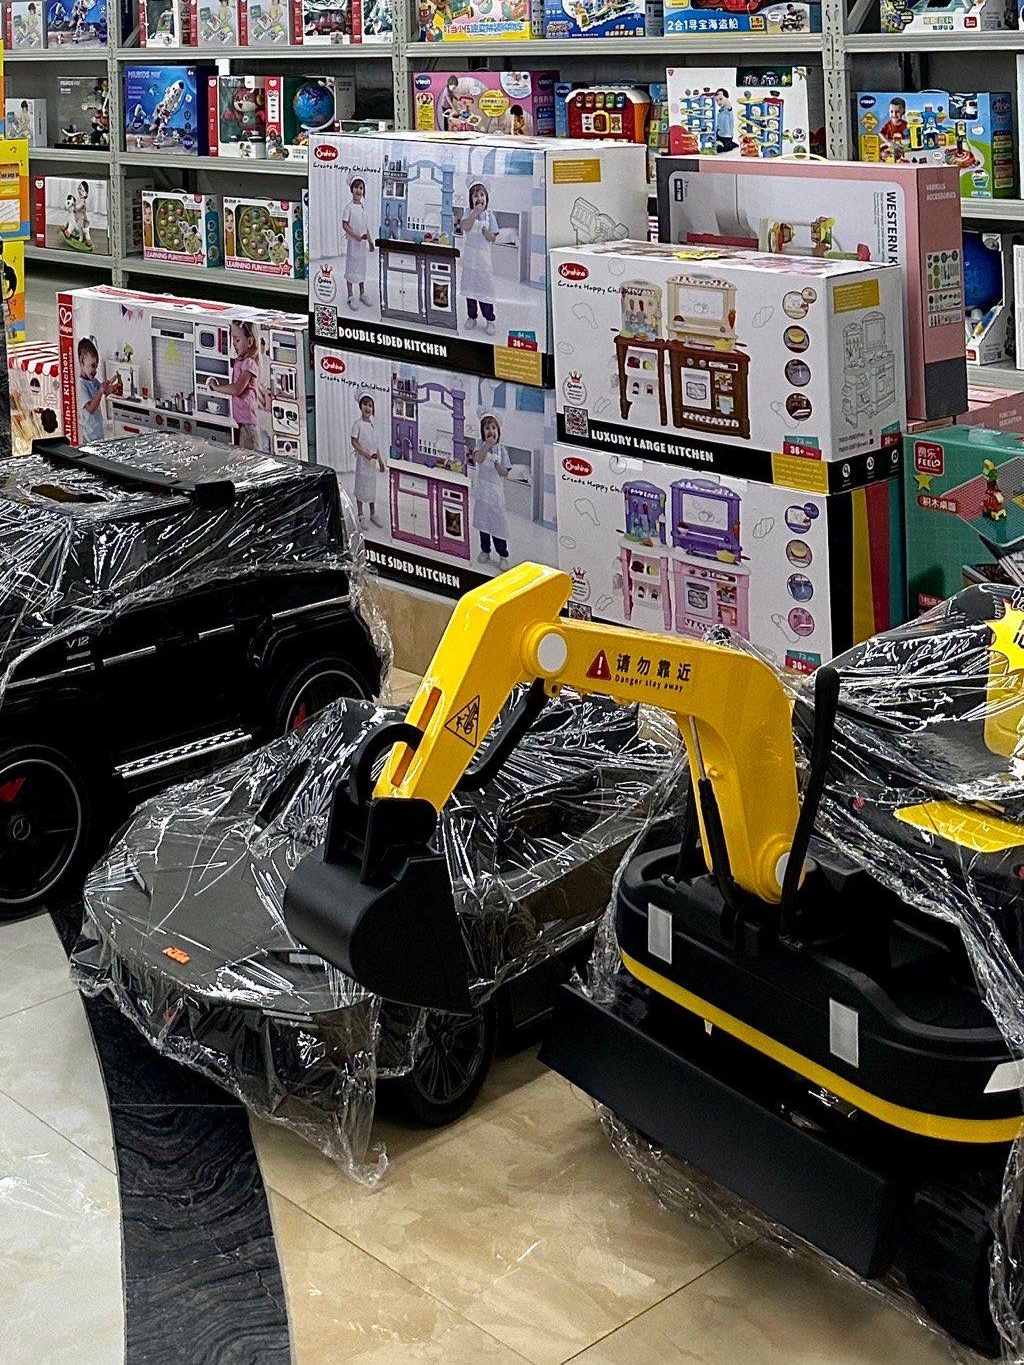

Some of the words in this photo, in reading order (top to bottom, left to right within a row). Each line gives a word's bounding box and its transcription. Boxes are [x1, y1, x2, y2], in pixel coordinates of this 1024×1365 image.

[668, 18, 739, 31] 2合1寻宝海盗船
[313, 161, 332, 169] Create
[334, 163, 352, 174] Happy
[352, 164, 381, 173] Childhood
[886, 191, 898, 252] WESTERN
[145, 250, 167, 260] LEARNING
[226, 259, 251, 270] LEARNING
[888, 256, 898, 264] K
[558, 275, 582, 289] Create
[584, 284, 606, 294] Happy
[338, 326, 375, 344] DOUBLE
[376, 333, 403, 349] SIDED
[404, 338, 447, 357] KITCHEN
[62, 352, 70, 396] Kitchen
[319, 373, 340, 383] Create
[341, 377, 360, 389] Happy
[360, 381, 390, 393] Childhood
[590, 429, 633, 447] LUXURY
[633, 437, 667, 454] LARGE
[667, 443, 714, 463] KITCHEN
[789, 445, 805, 455] 36+
[562, 474, 585, 485] Create
[586, 480, 609, 493] Happy
[366, 549, 387, 566] UBLE
[387, 556, 414, 574] SIDED
[416, 564, 460, 589] KITCHEN
[66, 636, 90, 648] V12
[616, 653, 692, 682] 请勿靠近
[615, 674, 643, 686] Danger
[645, 679, 662, 689] stay
[663, 683, 684, 693] away
